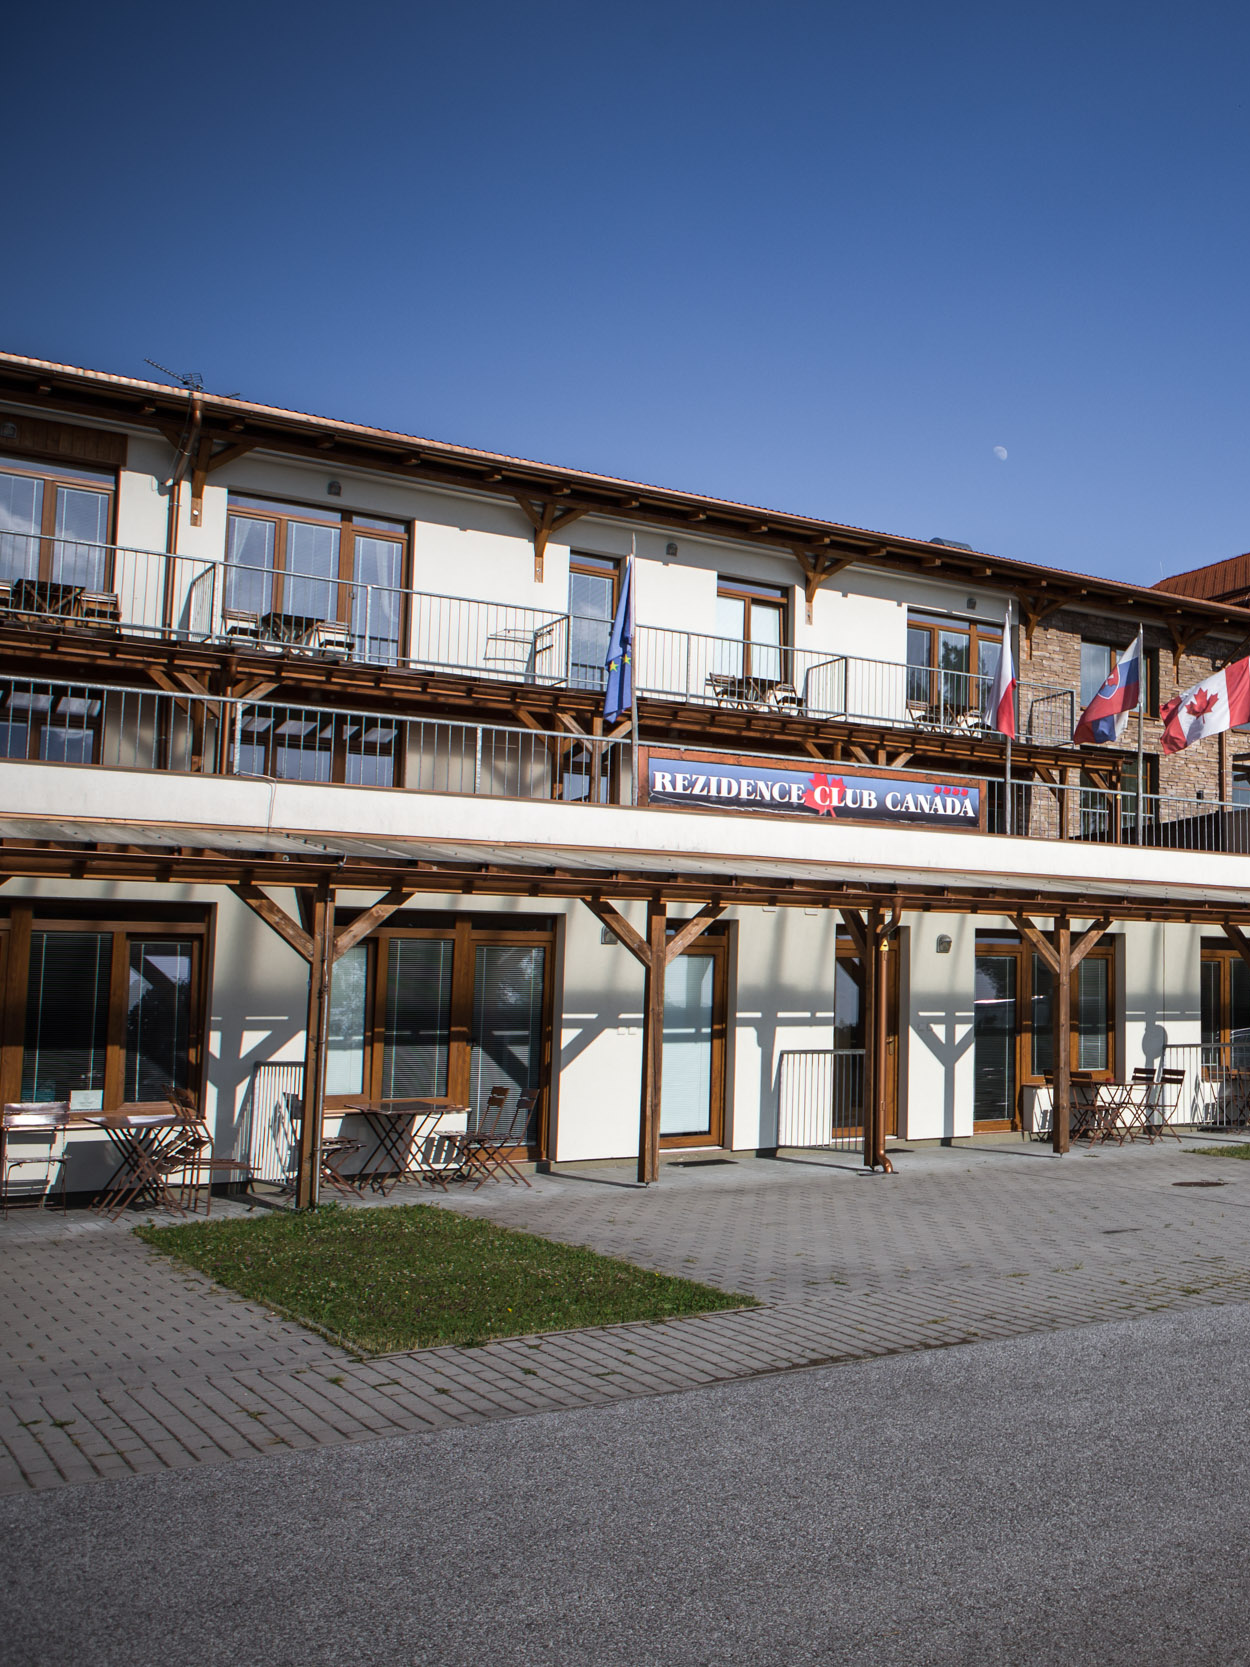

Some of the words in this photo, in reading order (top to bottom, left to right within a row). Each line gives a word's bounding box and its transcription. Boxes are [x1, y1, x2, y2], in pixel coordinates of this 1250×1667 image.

[653, 771, 806, 804] REZIDENCE
[813, 785, 878, 810] CLUB
[885, 791, 976, 818] CANADA
